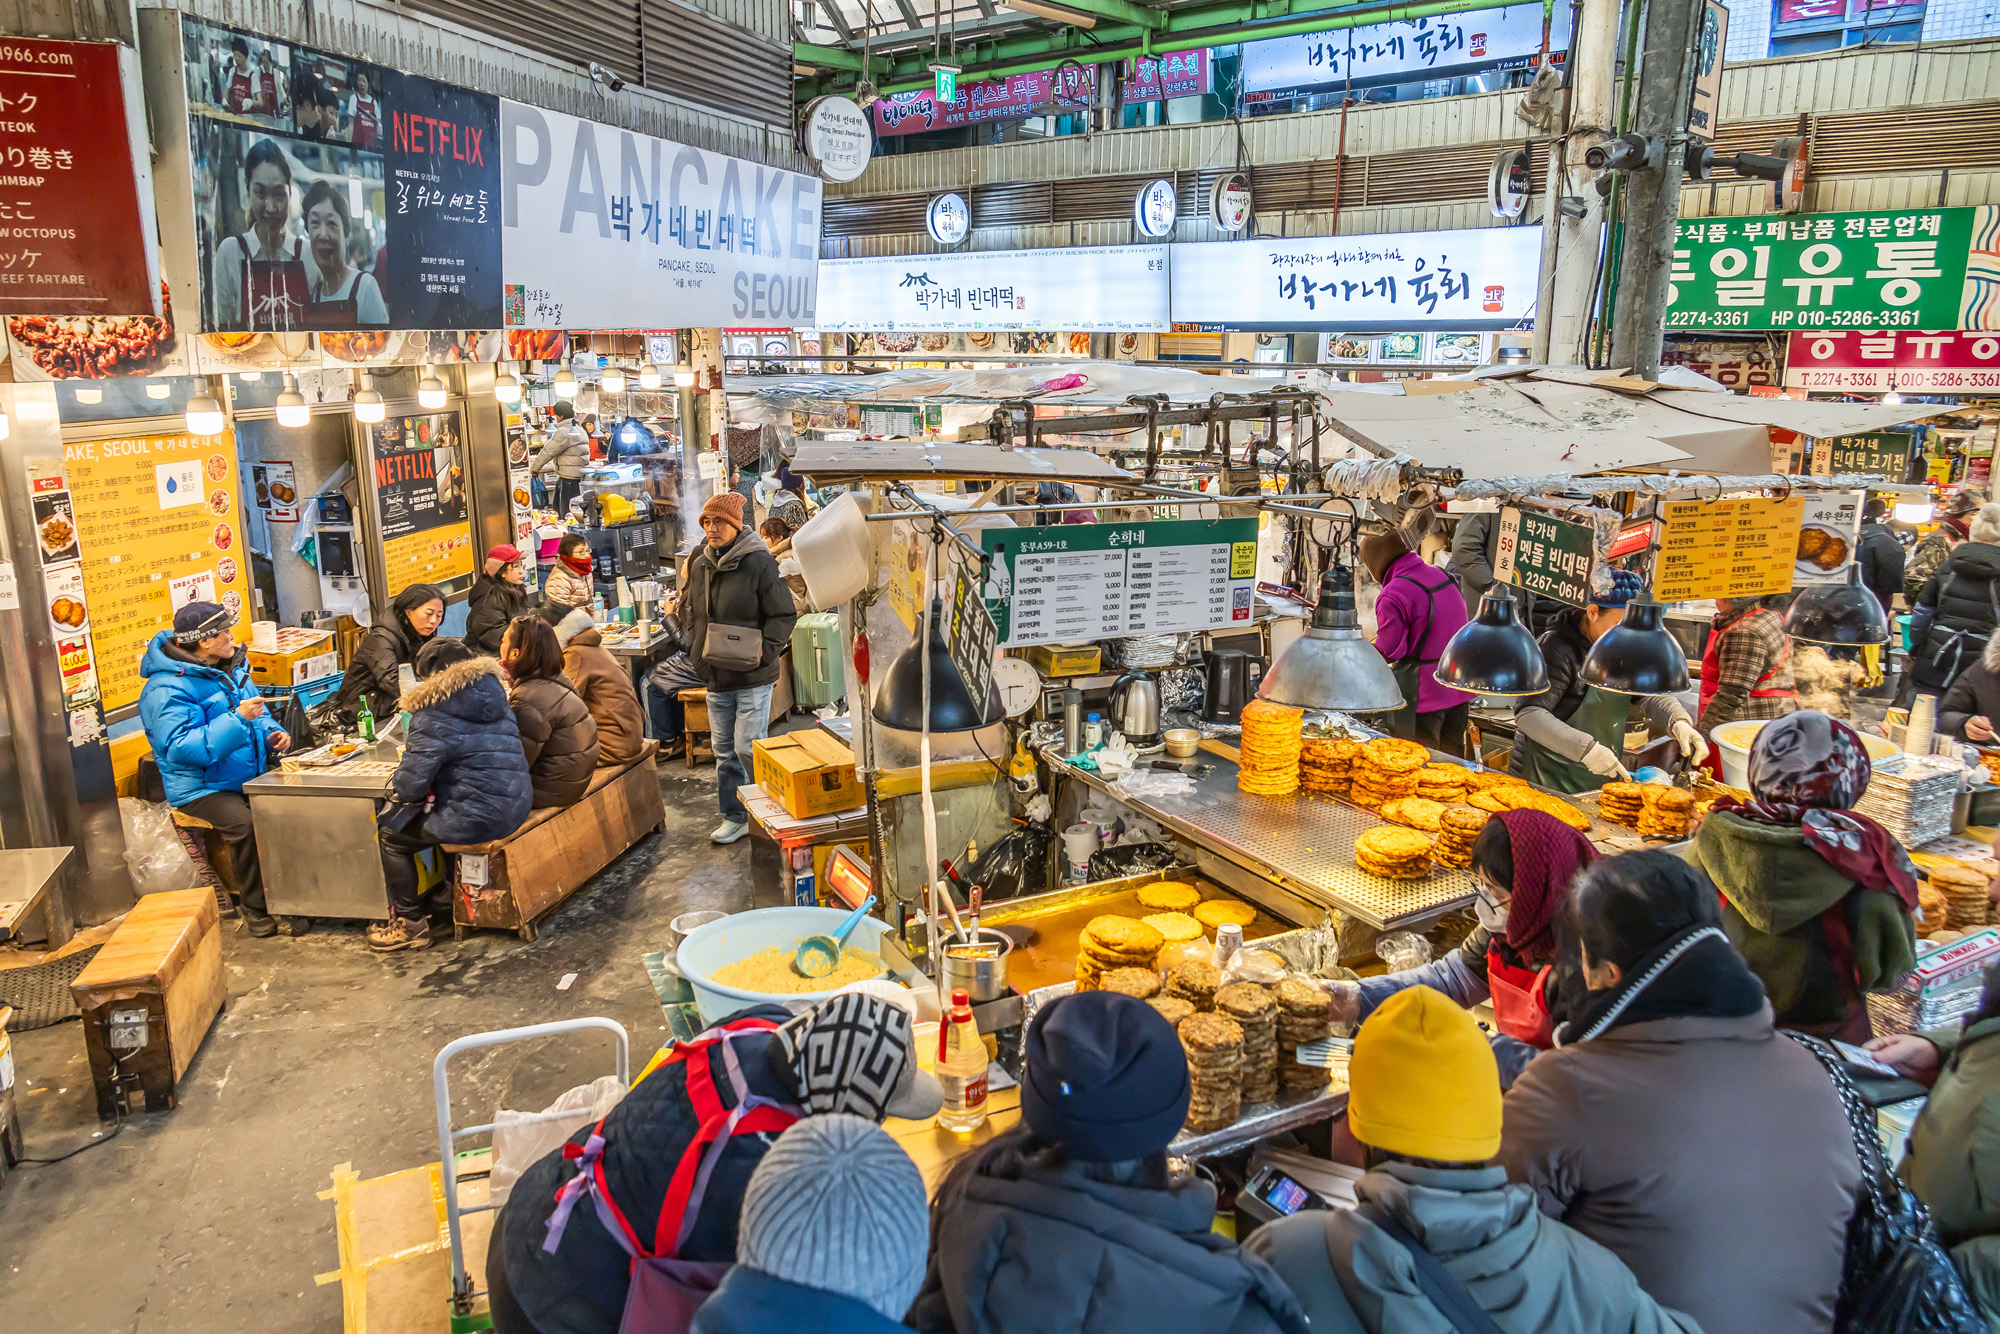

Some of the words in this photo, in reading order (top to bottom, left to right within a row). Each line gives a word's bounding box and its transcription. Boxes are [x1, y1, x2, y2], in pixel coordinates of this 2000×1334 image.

[1308, 36, 1404, 73] 박가네
[1139, 53, 1200, 83] 강력추천
[972, 86, 1010, 106] 패스트
[1013, 79, 1041, 101] 푸드
[1166, 79, 1200, 95] 강력추천.
[1246, 92, 1272, 104] NETFLIX
[820, 111, 840, 123] 박가네
[843, 115, 863, 126] 빈대떡
[882, 97, 933, 129] 빈대떡
[393, 110, 484, 167] NETFLIX
[395, 169, 419, 179] NETFLIX
[503, 104, 817, 260] PANCAKE
[396, 180, 410, 214] 길
[416, 185, 445, 209] 위의
[1842, 214, 1942, 239] 전문업체
[13, 228, 76, 240] OCTOPUS
[658, 258, 693, 275] PANCAKE,
[695, 261, 716, 274] SEOUL
[1148, 258, 1163, 271] 본점
[0, 273, 24, 284] EEF
[28, 274, 86, 285] TARTARE
[1278, 273, 1397, 310] 박가네
[1407, 254, 1470, 314] 육회
[449, 284, 460, 294] 서울
[733, 270, 815, 320] SEOUL
[915, 287, 962, 311] 박가네
[967, 286, 1015, 311] 빈대떡
[1771, 311, 1793, 325] HP
[1797, 310, 1920, 326] 010-5286-3361
[1172, 322, 1199, 332] NETFLIX
[1801, 372, 1877, 387] T.2274-3361
[65, 443, 100, 462] AKE,
[102, 438, 151, 458] SEOUL
[1841, 437, 1879, 450] 박가네
[1815, 451, 1826, 461] 58
[136, 461, 153, 469] 5,000
[374, 451, 436, 489] NETFLIX
[1815, 464, 1824, 473] 호
[134, 474, 155, 483] 10,000
[136, 486, 156, 495] 10,000
[181, 483, 196, 493] SELF
[123, 506, 141, 516] 6,000
[1812, 510, 1855, 522] 새우완자
[190, 520, 211, 531] 20,000
[1502, 520, 1518, 535] 동부A
[1526, 518, 1557, 543] 박가네
[1107, 530, 1146, 547] 순희네
[1500, 537, 1514, 553] 59
[1104, 553, 1123, 561] 27,000
[1210, 557, 1228, 565] 10,000
[1499, 556, 1510, 571] 호
[1519, 539, 1545, 568] 멧돌
[1548, 547, 1590, 582] 빈대떡
[1209, 567, 1227, 575] 35,000
[1209, 587, 1225, 595] 15,000
[1525, 571, 1585, 603] 2267-0614
[149, 590, 166, 599] 5,000
[1102, 603, 1120, 611] 10,000
[1209, 606, 1224, 614] 4,000
[122, 610, 138, 619] 7,000
[1102, 614, 1119, 622] 10,000
[1209, 616, 1224, 624] 3,000
[184, 628, 218, 641] SPORTS
[1101, 625, 1119, 633] 15,000
